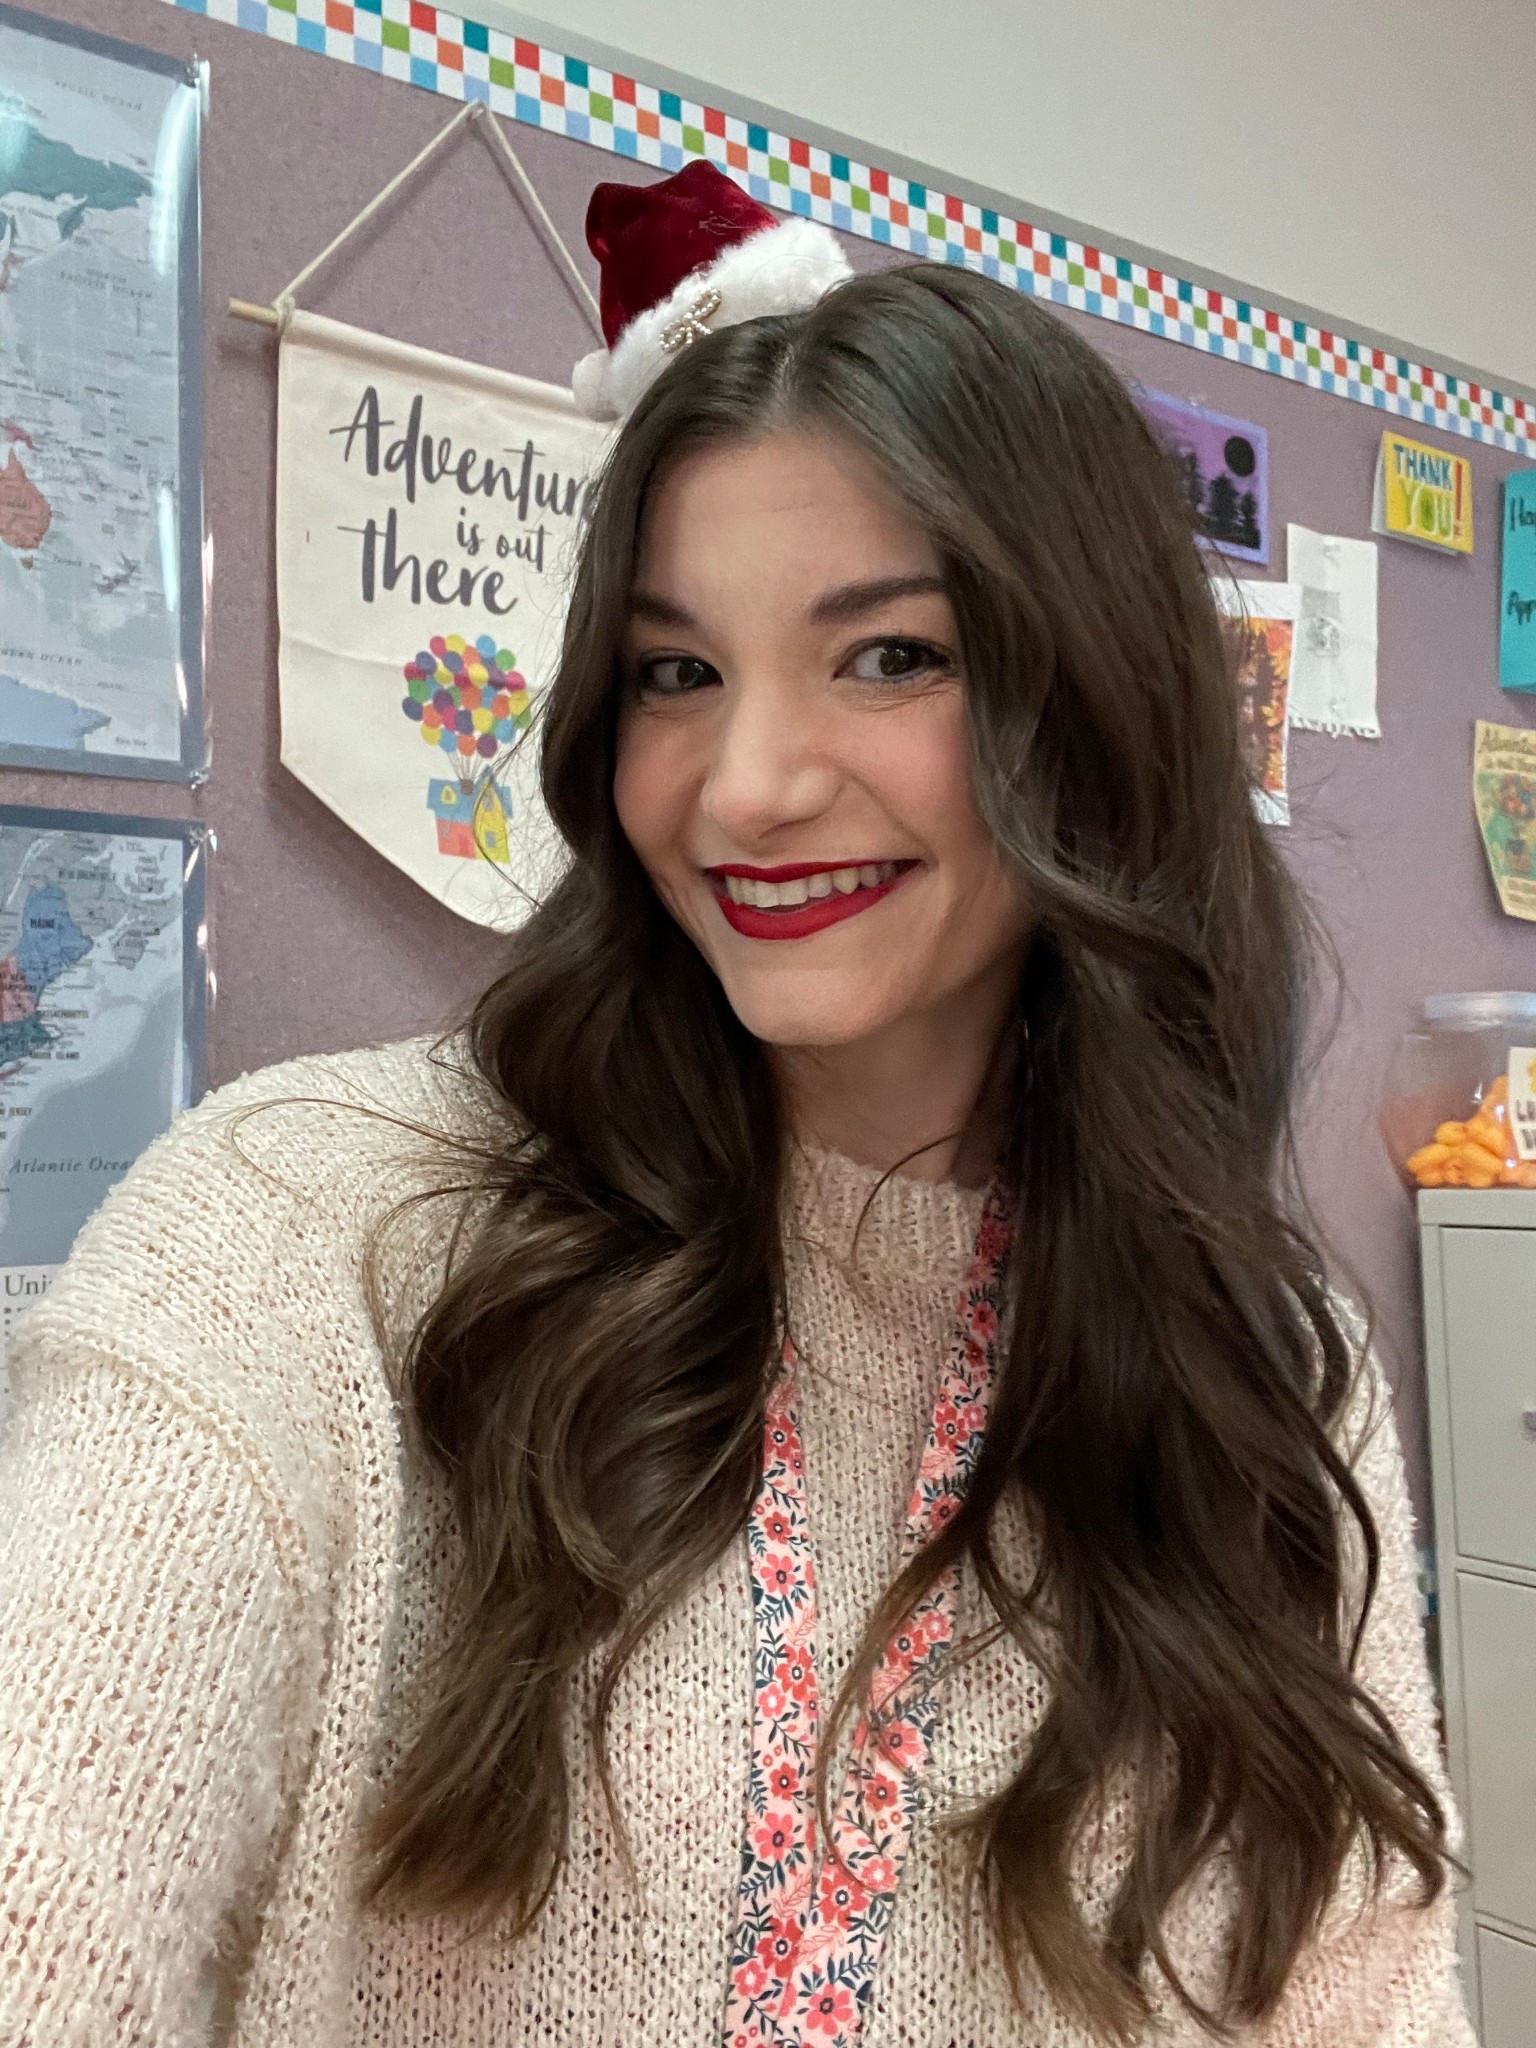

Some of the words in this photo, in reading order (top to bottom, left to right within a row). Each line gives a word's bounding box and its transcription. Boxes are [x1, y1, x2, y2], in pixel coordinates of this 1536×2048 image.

[1393, 444, 1452, 491] THANK
[337, 507, 518, 615] there
[457, 506, 482, 557] is
[496, 524, 552, 573] out
[9, 1158, 82, 1174] Atlantic
[5, 1273, 53, 1297] Uni
